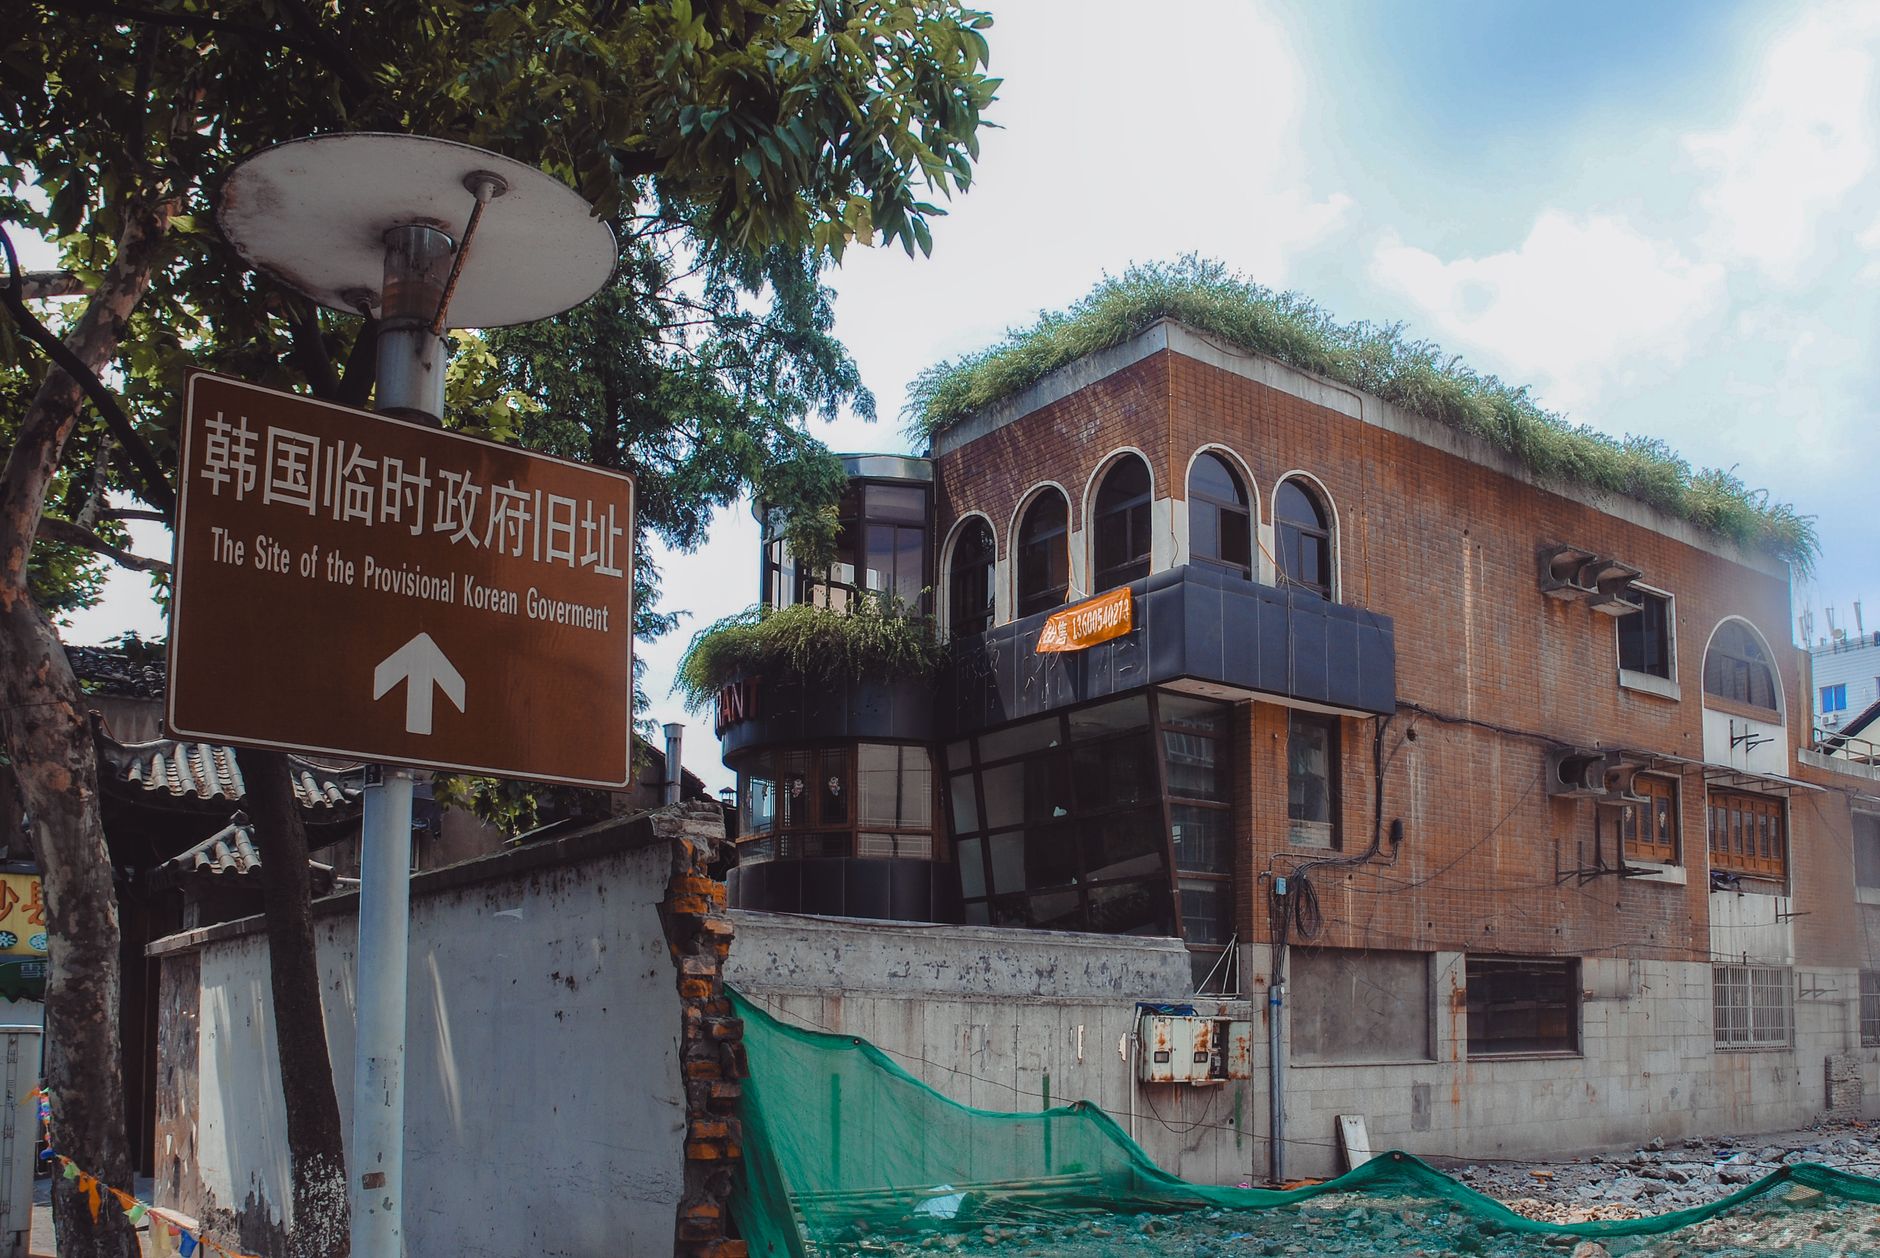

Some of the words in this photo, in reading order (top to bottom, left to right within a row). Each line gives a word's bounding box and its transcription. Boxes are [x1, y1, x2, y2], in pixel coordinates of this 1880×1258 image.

[201, 411, 623, 578] 韩国临时政府旧址
[211, 526, 245, 566] The
[254, 534, 291, 574] Site
[300, 544, 319, 578] of
[326, 552, 355, 585] the
[363, 555, 456, 604] Provisional
[463, 574, 518, 616] Korean
[526, 587, 610, 633] Goverment
[1042, 621, 1068, 645] 出售
